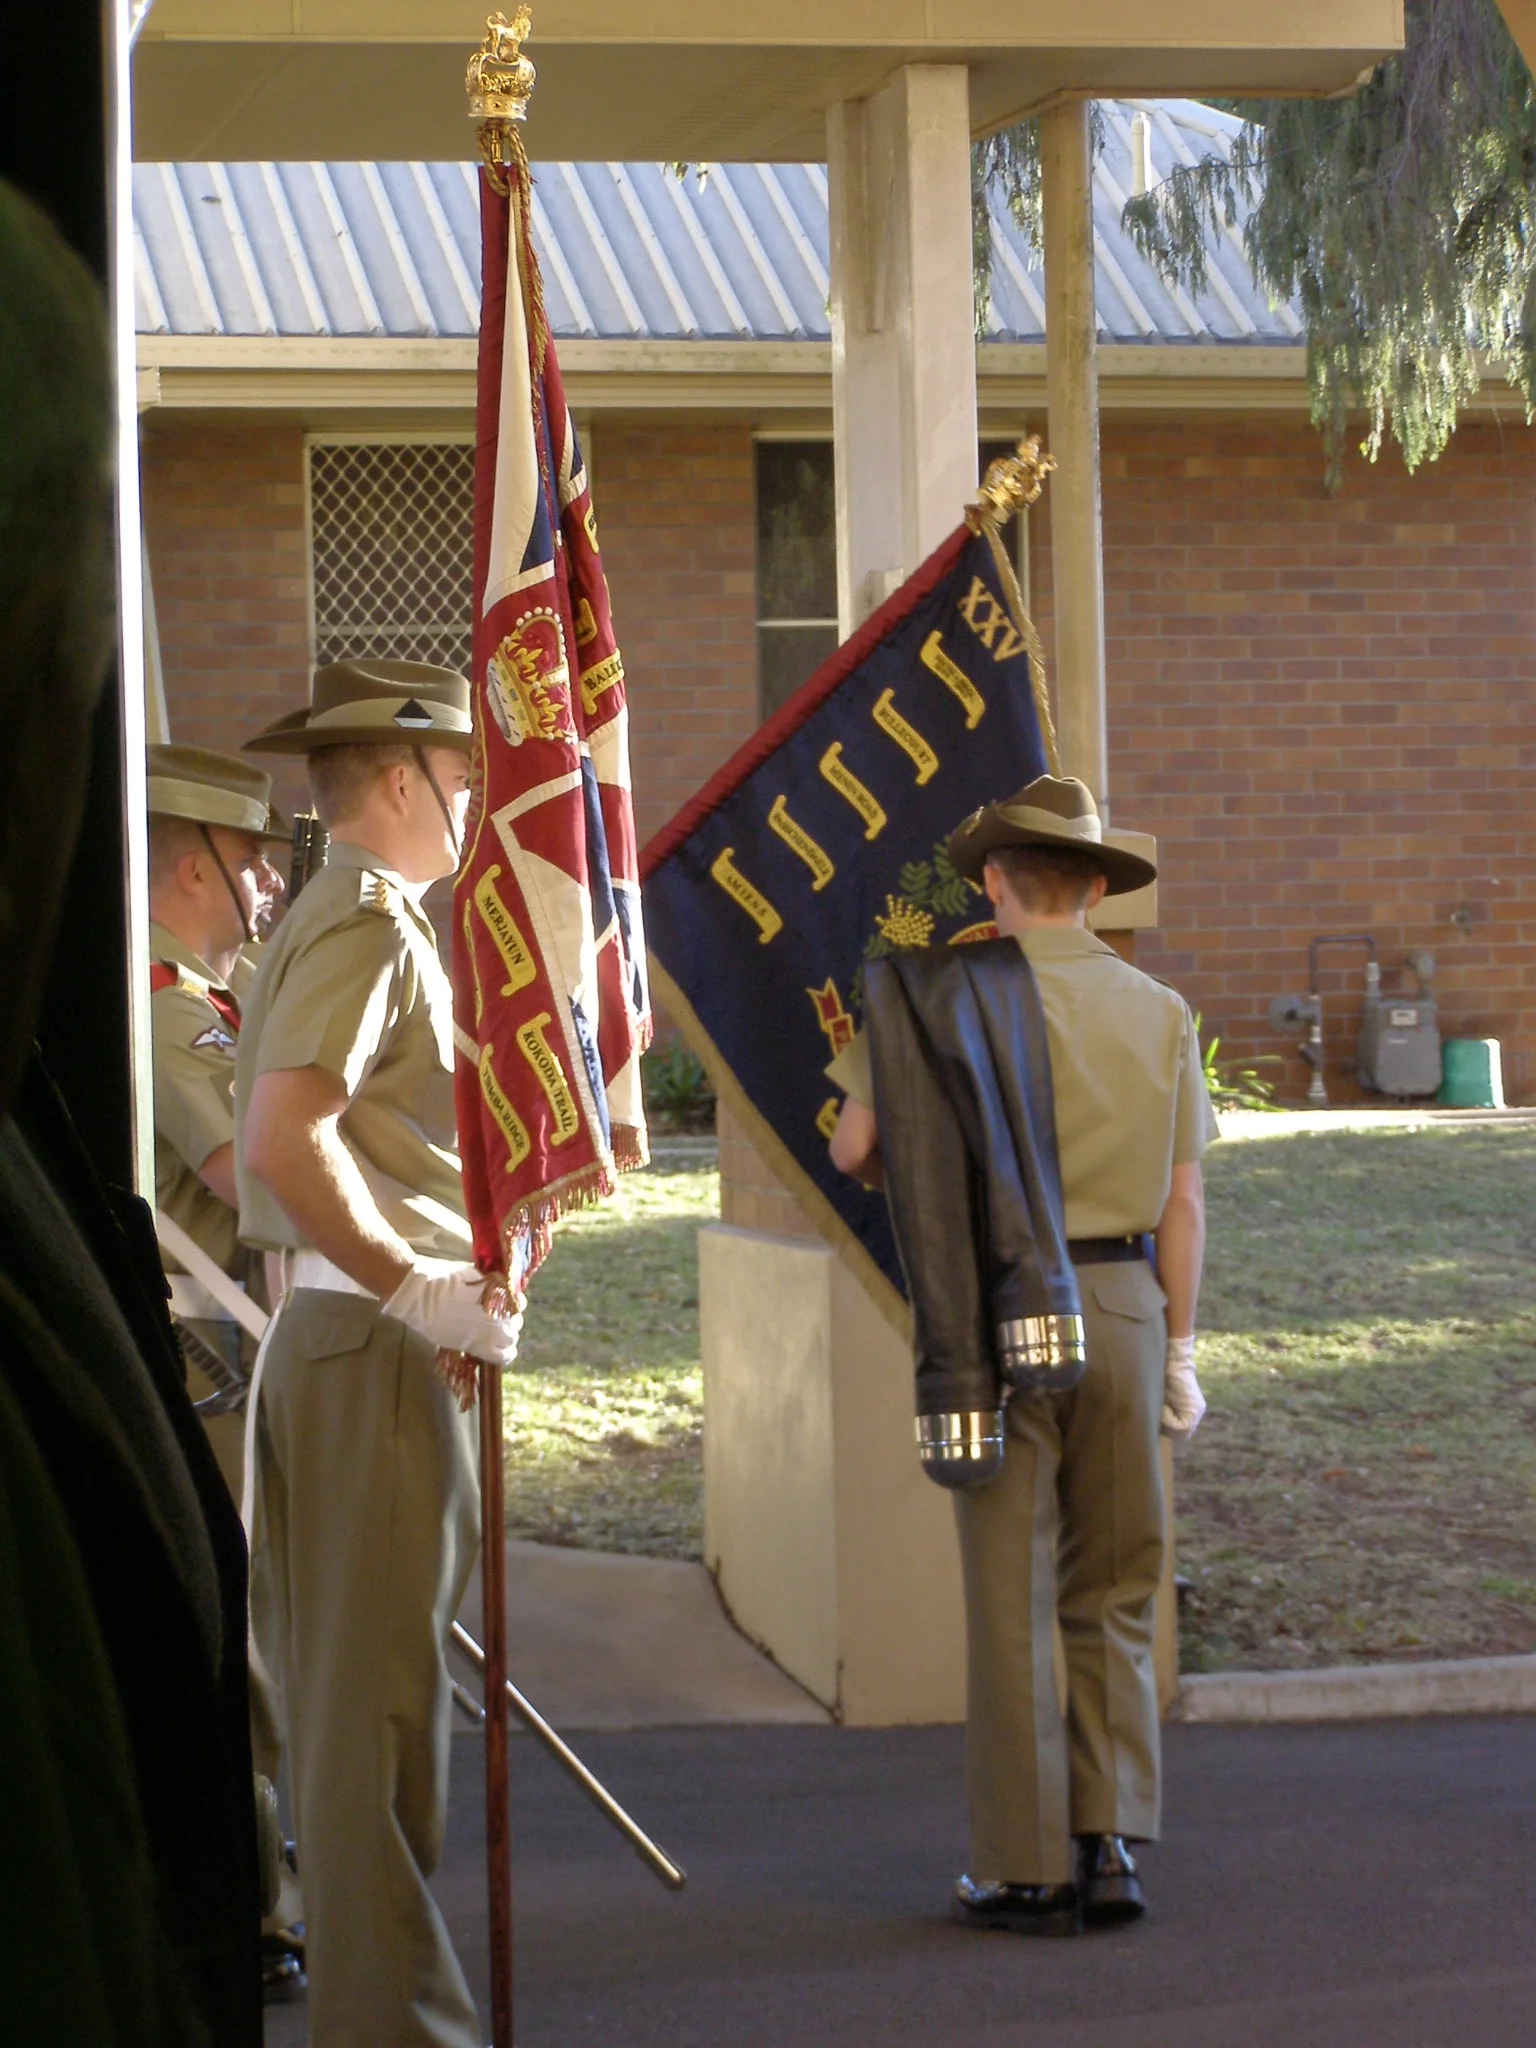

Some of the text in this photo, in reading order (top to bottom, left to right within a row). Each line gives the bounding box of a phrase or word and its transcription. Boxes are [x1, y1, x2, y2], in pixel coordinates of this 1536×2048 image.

[958, 574, 1027, 662] XXV
[480, 894, 525, 966] MERJAYUN
[725, 874, 767, 918] AMIENS
[522, 1029, 574, 1133] KOKODA TRAIL
[501, 1111, 525, 1152] RIDGE
